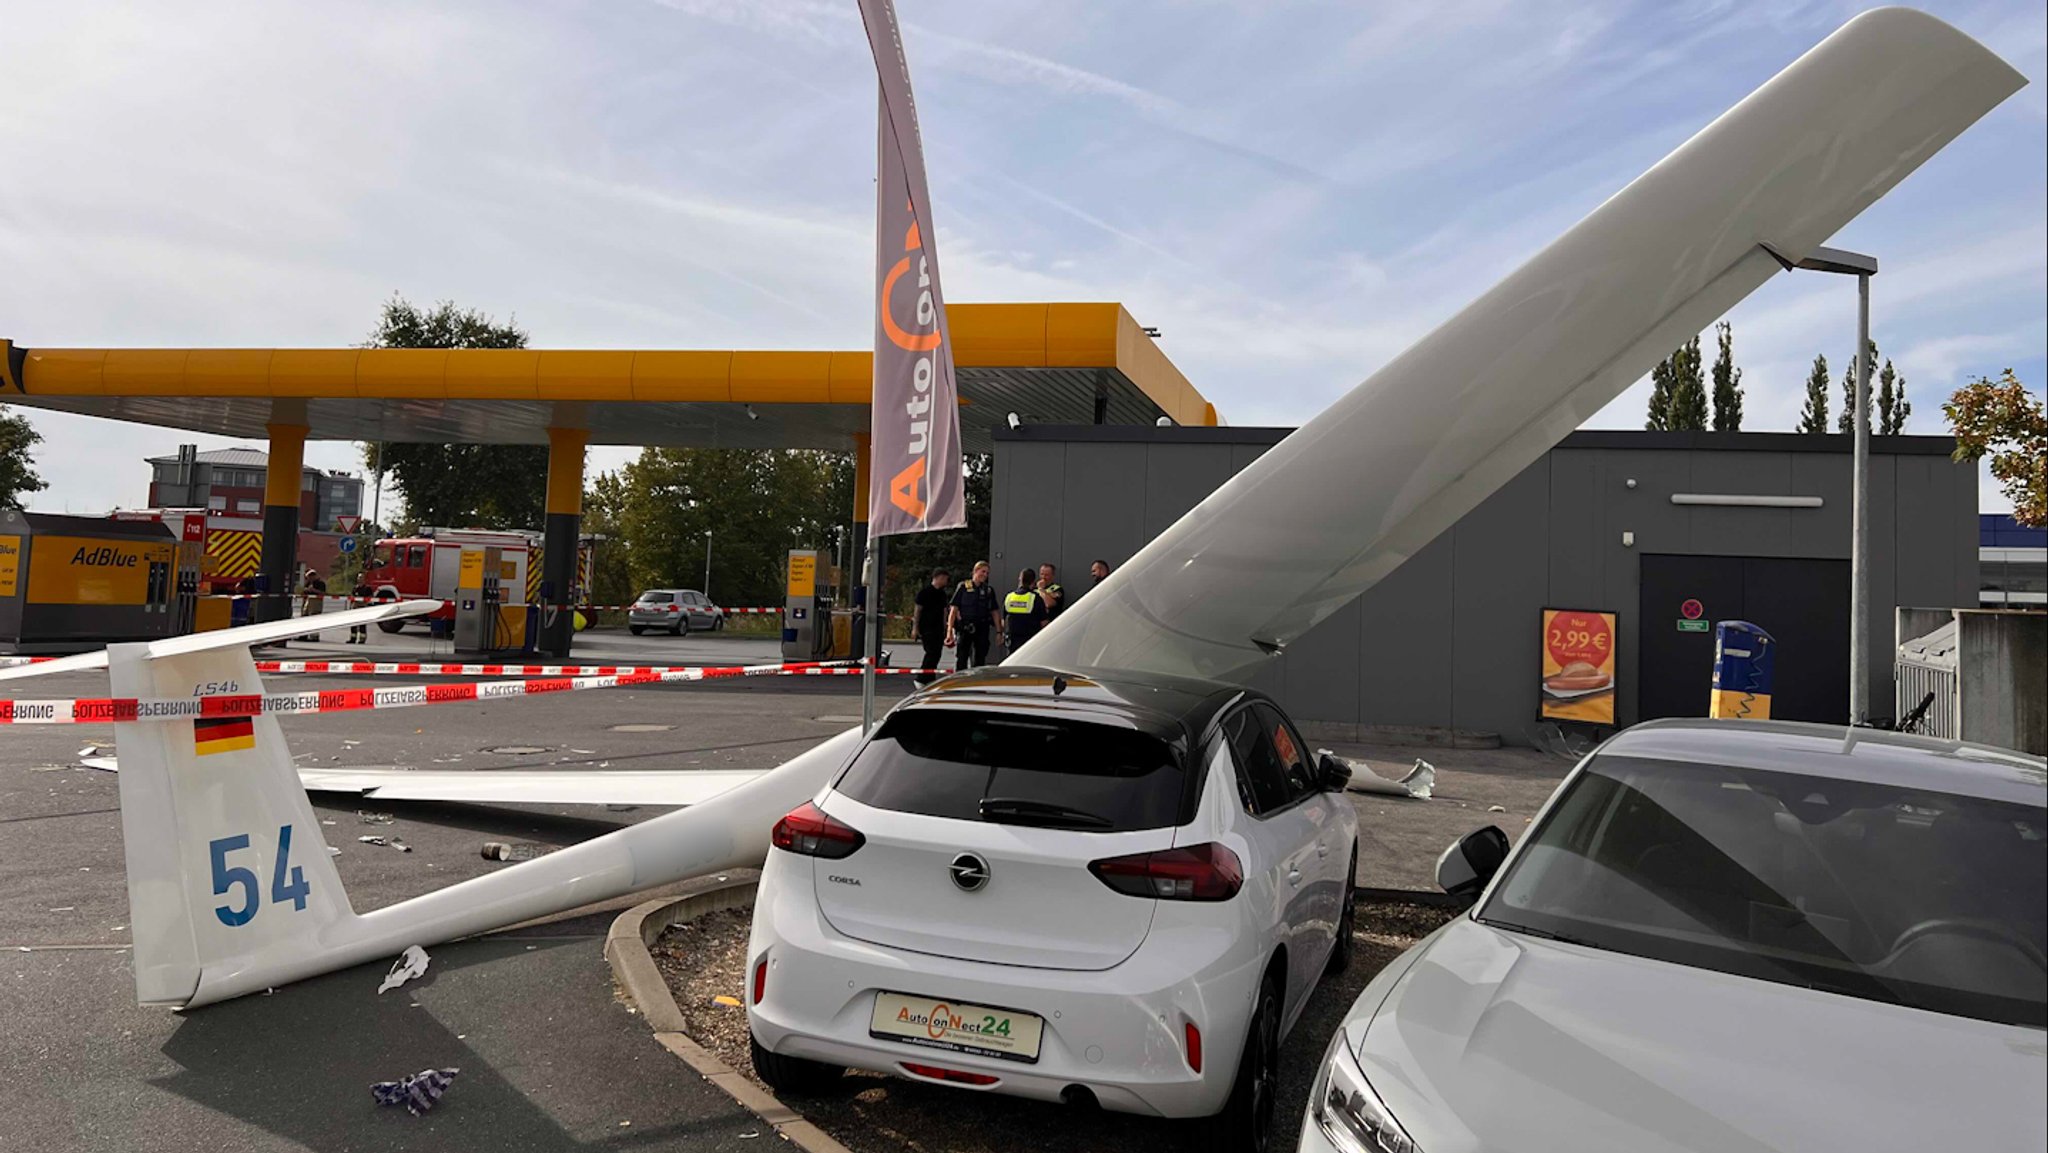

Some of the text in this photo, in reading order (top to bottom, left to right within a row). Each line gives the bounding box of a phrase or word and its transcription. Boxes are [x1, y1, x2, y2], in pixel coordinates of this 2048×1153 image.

[71, 547, 138, 567] AdBlue
[1571, 619, 1587, 627] Nur
[1551, 629, 1608, 650] 2,99 €
[193, 680, 238, 696] LS4b
[209, 824, 310, 927] 54
[828, 874, 861, 887] CORSA
